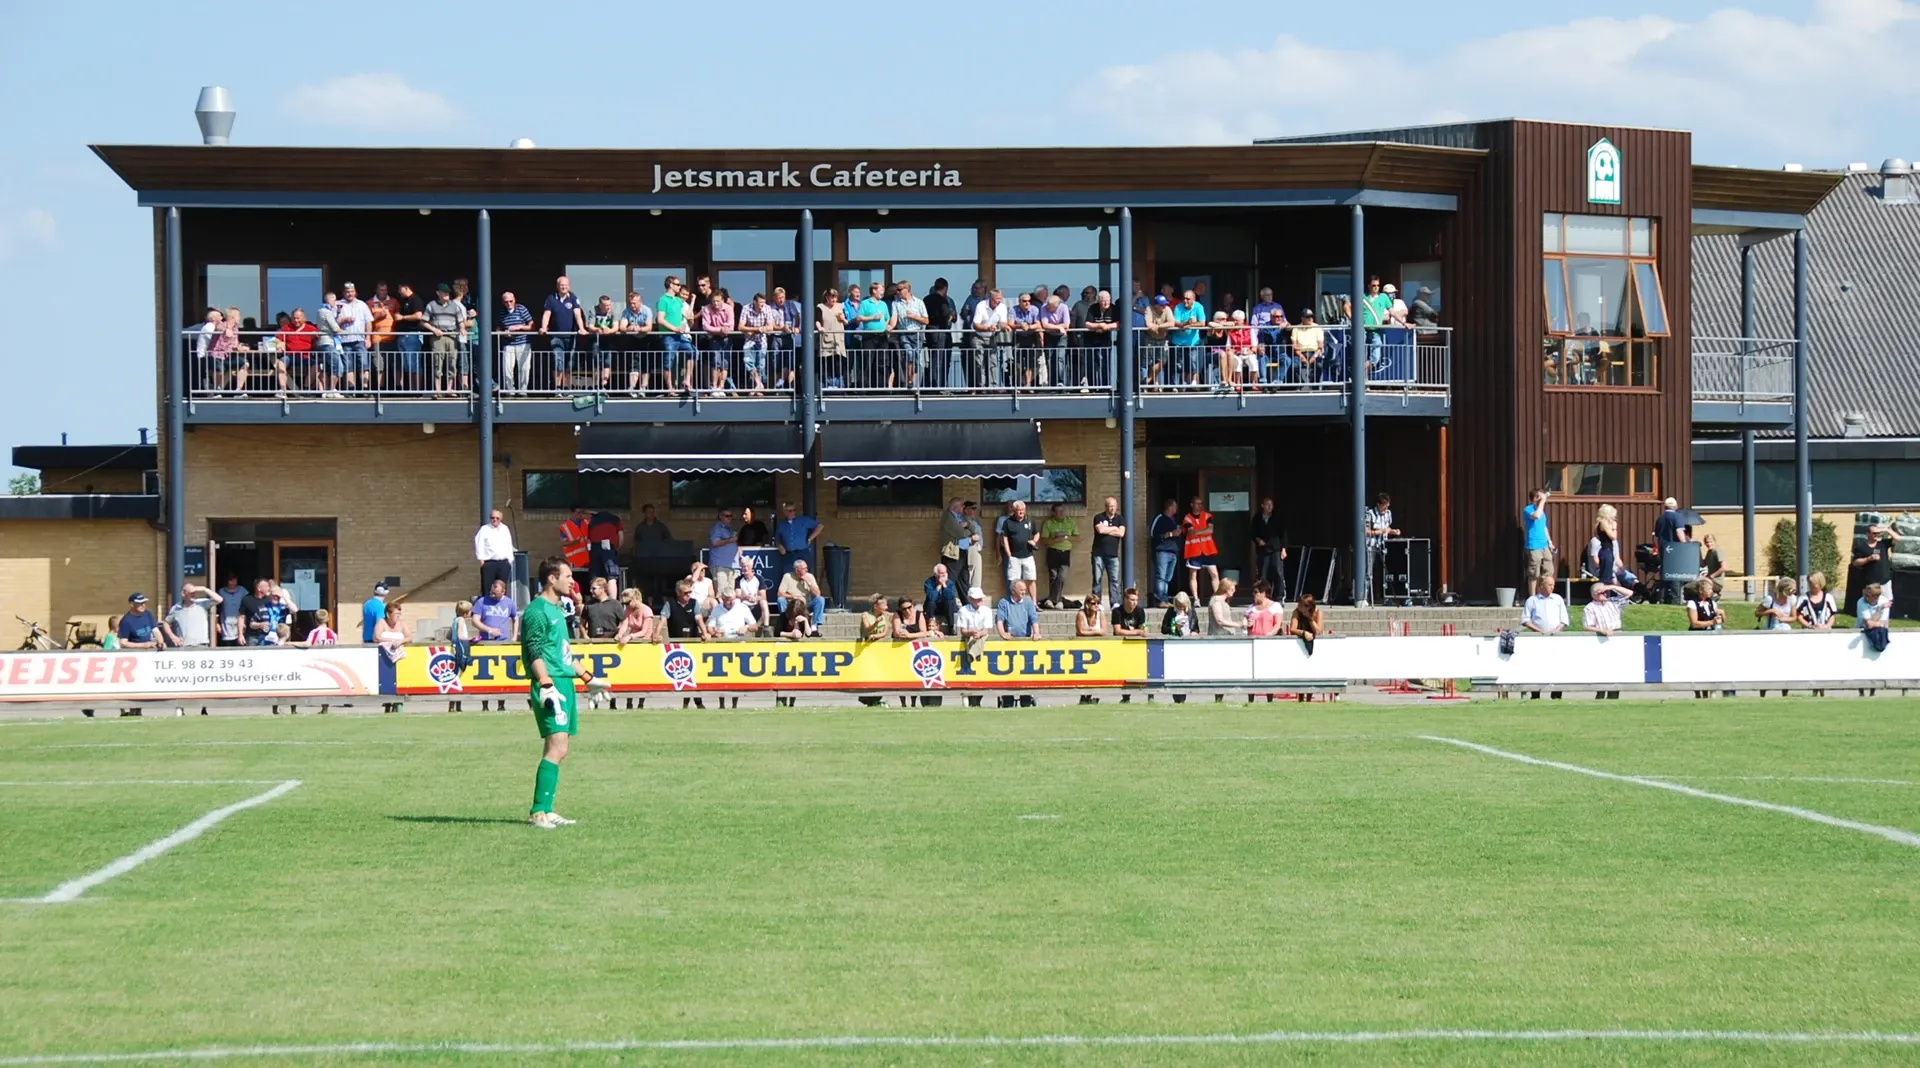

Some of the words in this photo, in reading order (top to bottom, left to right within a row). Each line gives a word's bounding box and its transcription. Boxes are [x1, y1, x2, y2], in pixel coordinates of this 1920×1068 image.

[652, 161, 801, 193] Jetsmark
[809, 161, 962, 188] Cafeteria
[0, 657, 138, 685] EJSER
[154, 660, 177, 670] TLF.
[181, 660, 196, 670] 98
[200, 659, 215, 669] 82
[220, 659, 235, 669] 39
[238, 659, 254, 668] 43
[702, 651, 854, 677] TULIP
[951, 649, 1101, 675] TULIP
[154, 672, 302, 685] www.jornsbusrejser.dk
